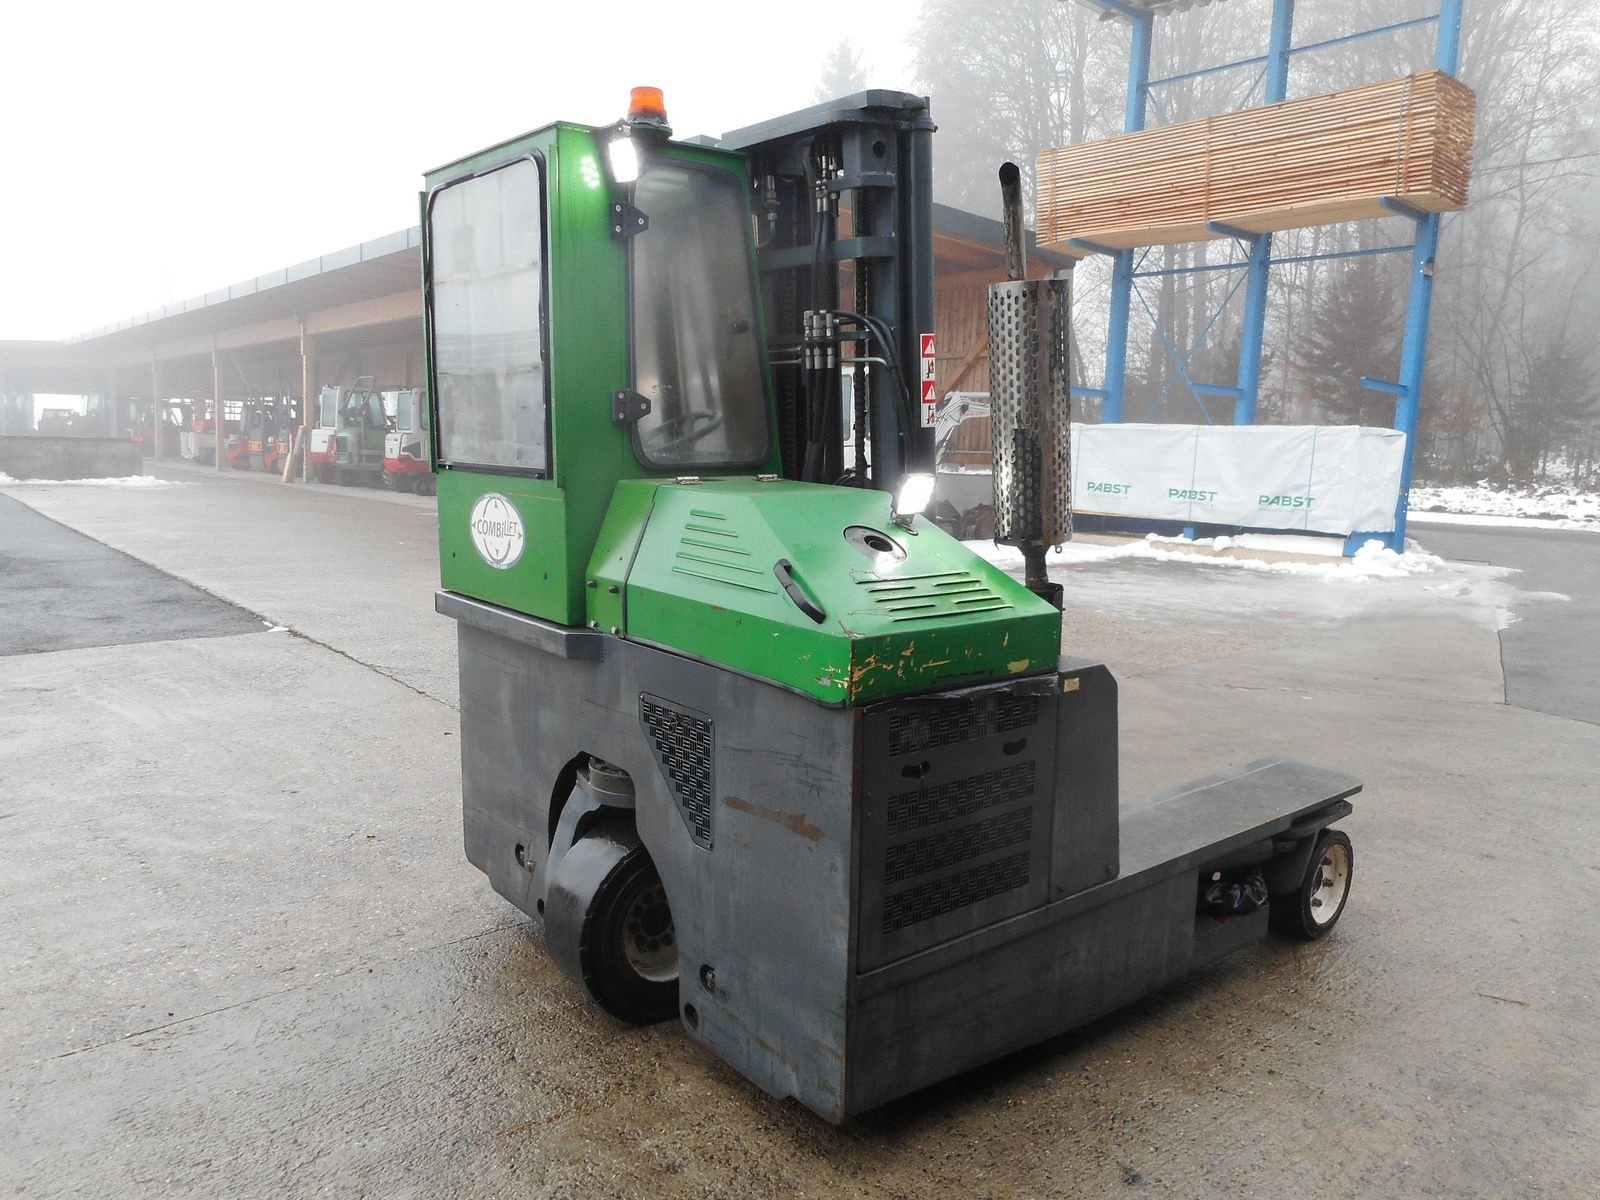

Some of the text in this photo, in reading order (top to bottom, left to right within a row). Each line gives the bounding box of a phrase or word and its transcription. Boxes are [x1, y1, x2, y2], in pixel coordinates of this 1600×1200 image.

[1087, 481, 1132, 495] PABST
[1168, 488, 1219, 502] PABST
[1258, 494, 1316, 508] PABST
